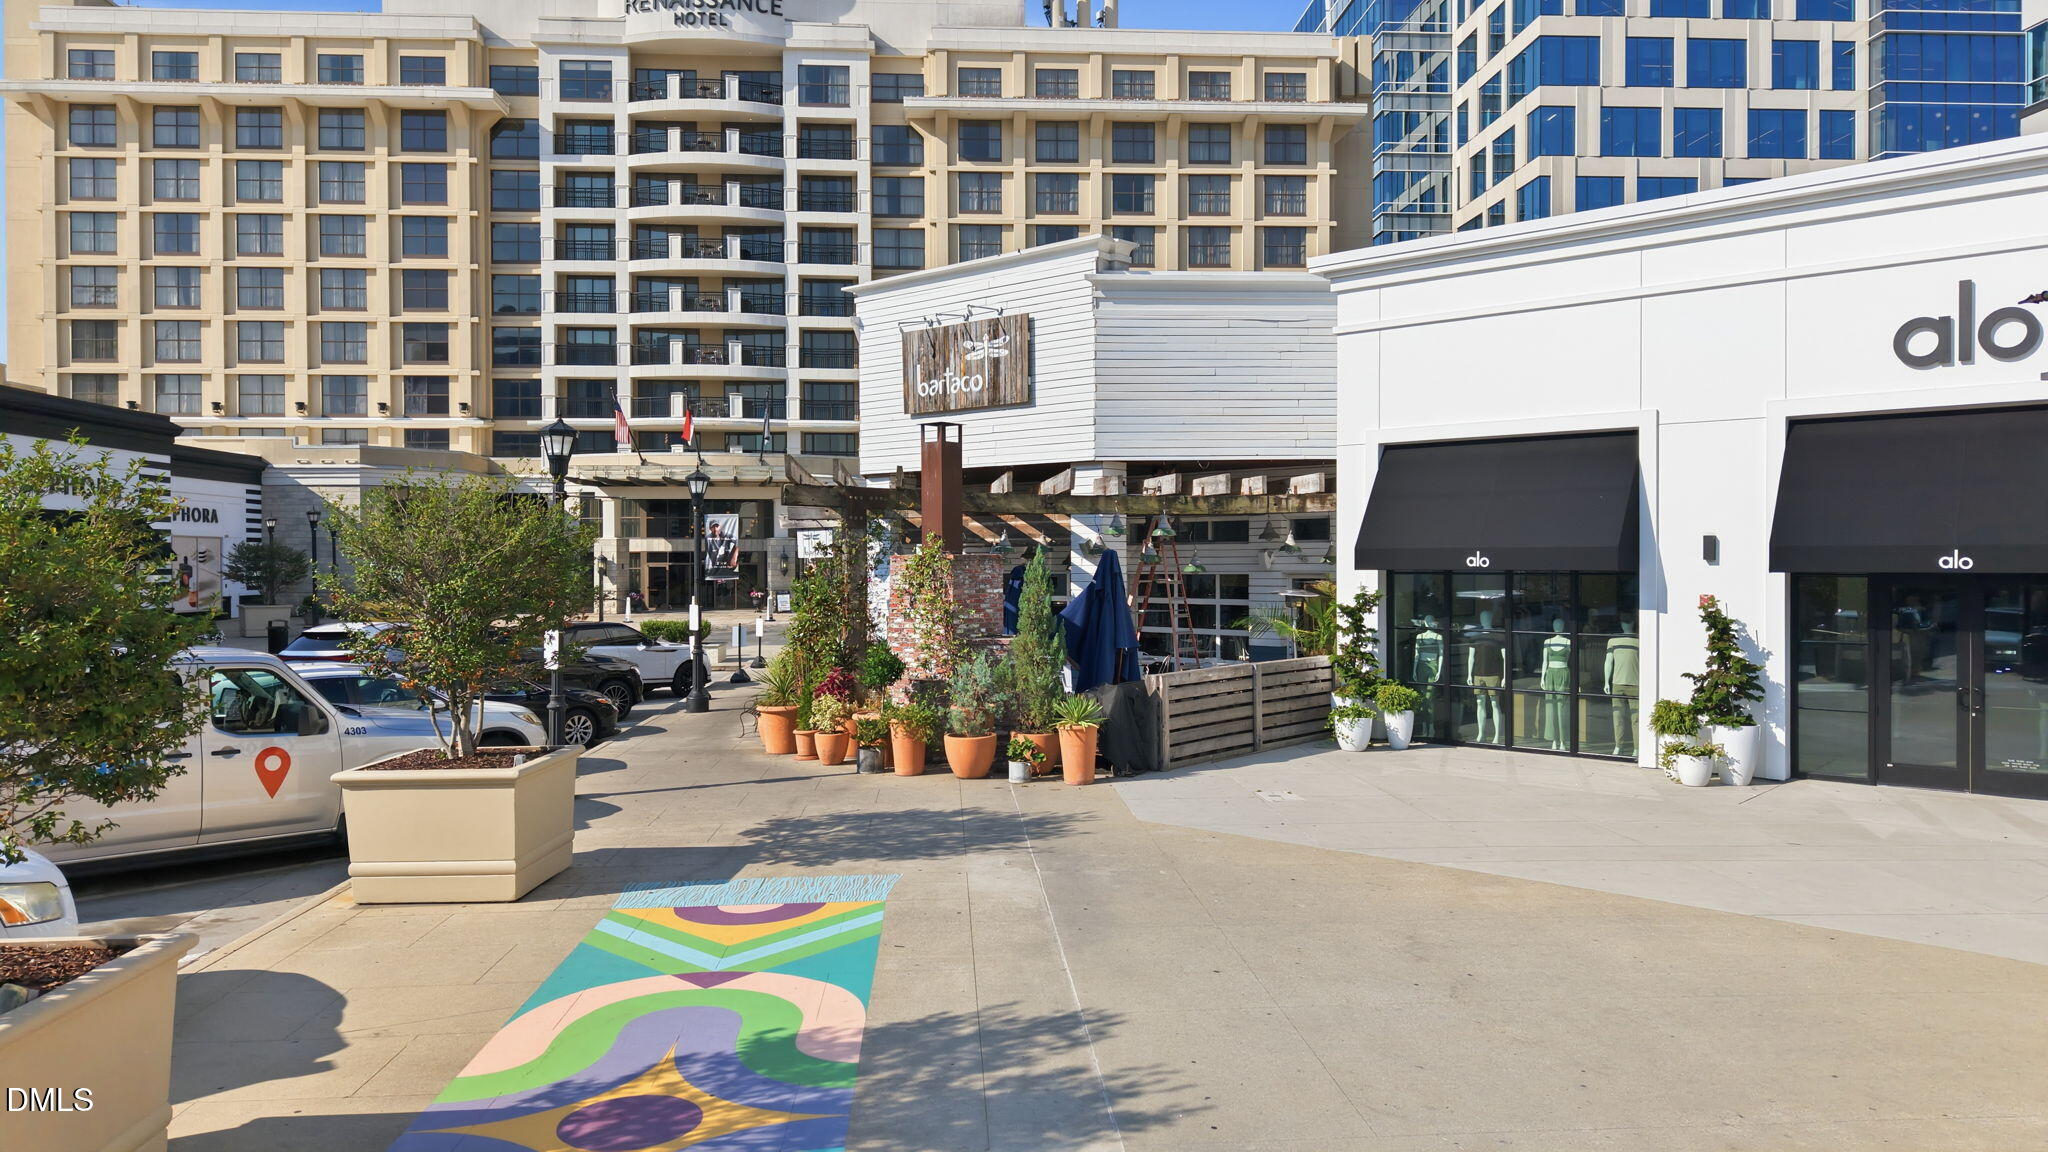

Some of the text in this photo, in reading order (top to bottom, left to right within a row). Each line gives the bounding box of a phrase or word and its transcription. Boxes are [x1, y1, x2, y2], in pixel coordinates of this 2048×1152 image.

[674, 12, 728, 26] HOTEL
[1893, 280, 2042, 368] alo
[916, 364, 983, 397] bartaco
[172, 506, 219, 524] PHORA
[1466, 550, 1490, 568] alo
[1938, 549, 1974, 570] alo
[344, 726, 368, 736] 4303
